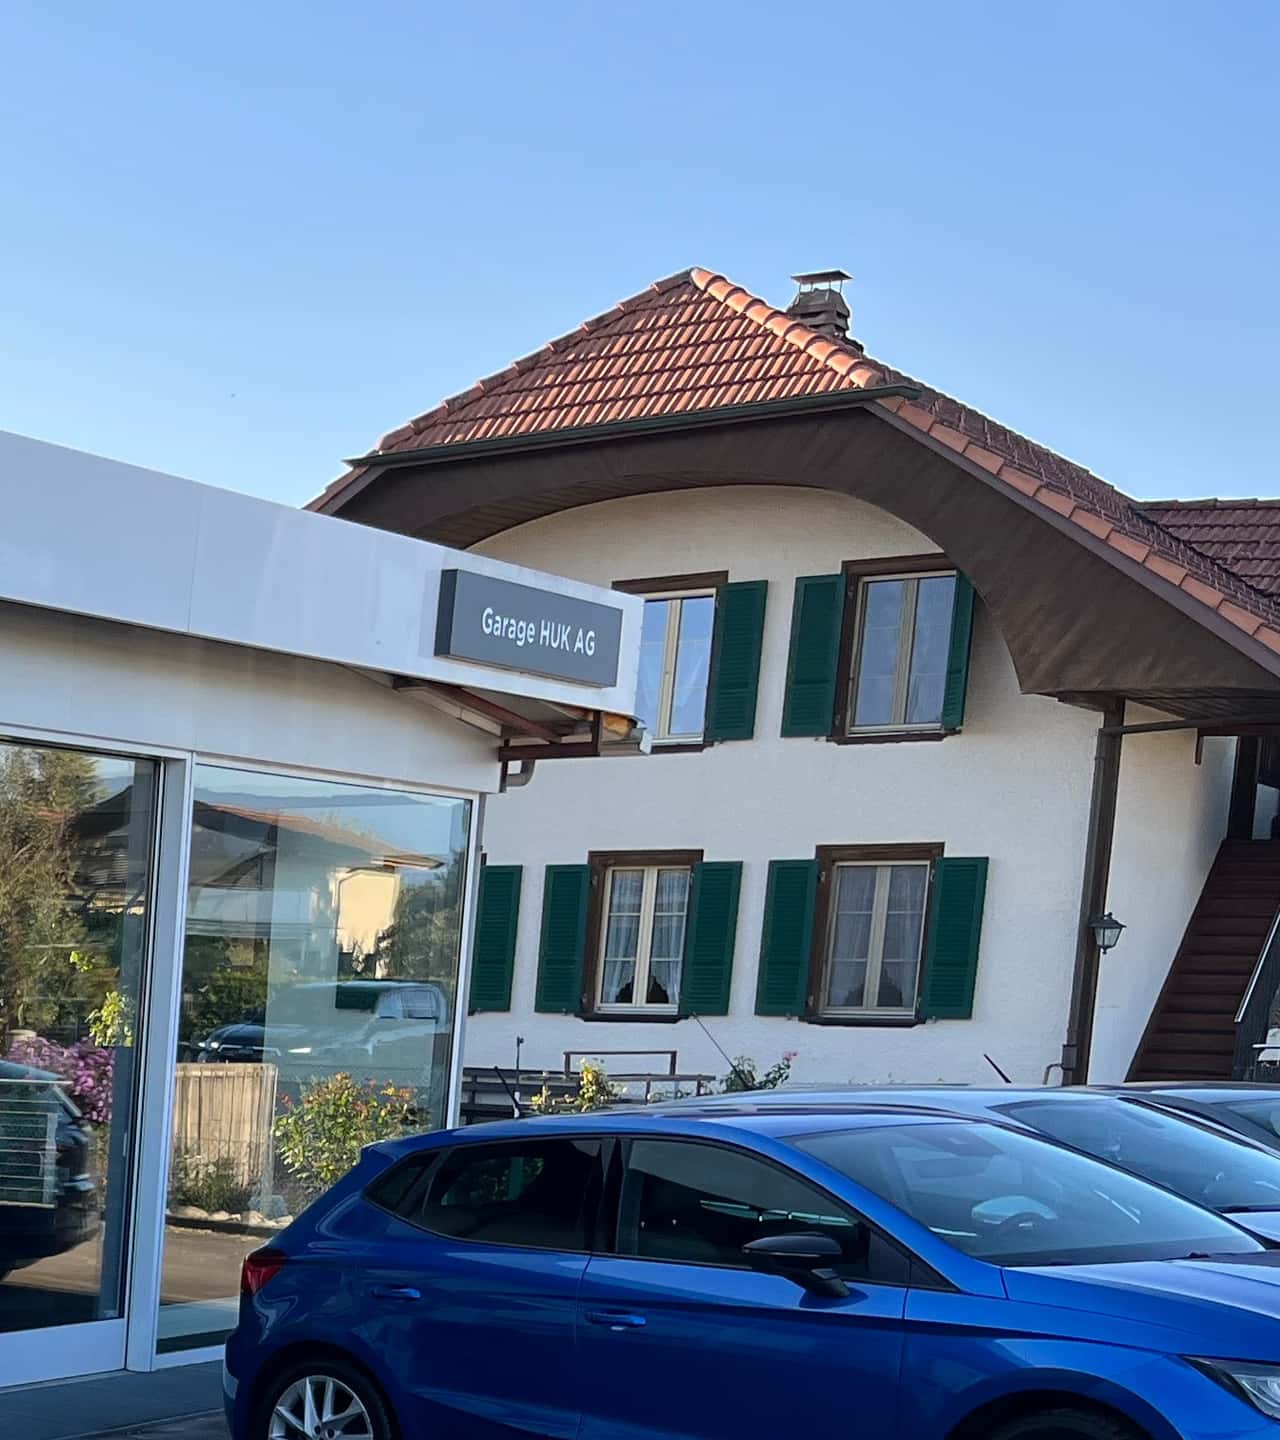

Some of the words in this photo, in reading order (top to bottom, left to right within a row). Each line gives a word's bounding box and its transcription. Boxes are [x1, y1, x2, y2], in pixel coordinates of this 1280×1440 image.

[481, 607, 535, 647] Garage
[539, 619, 570, 652] HUK
[573, 627, 596, 657] AG
